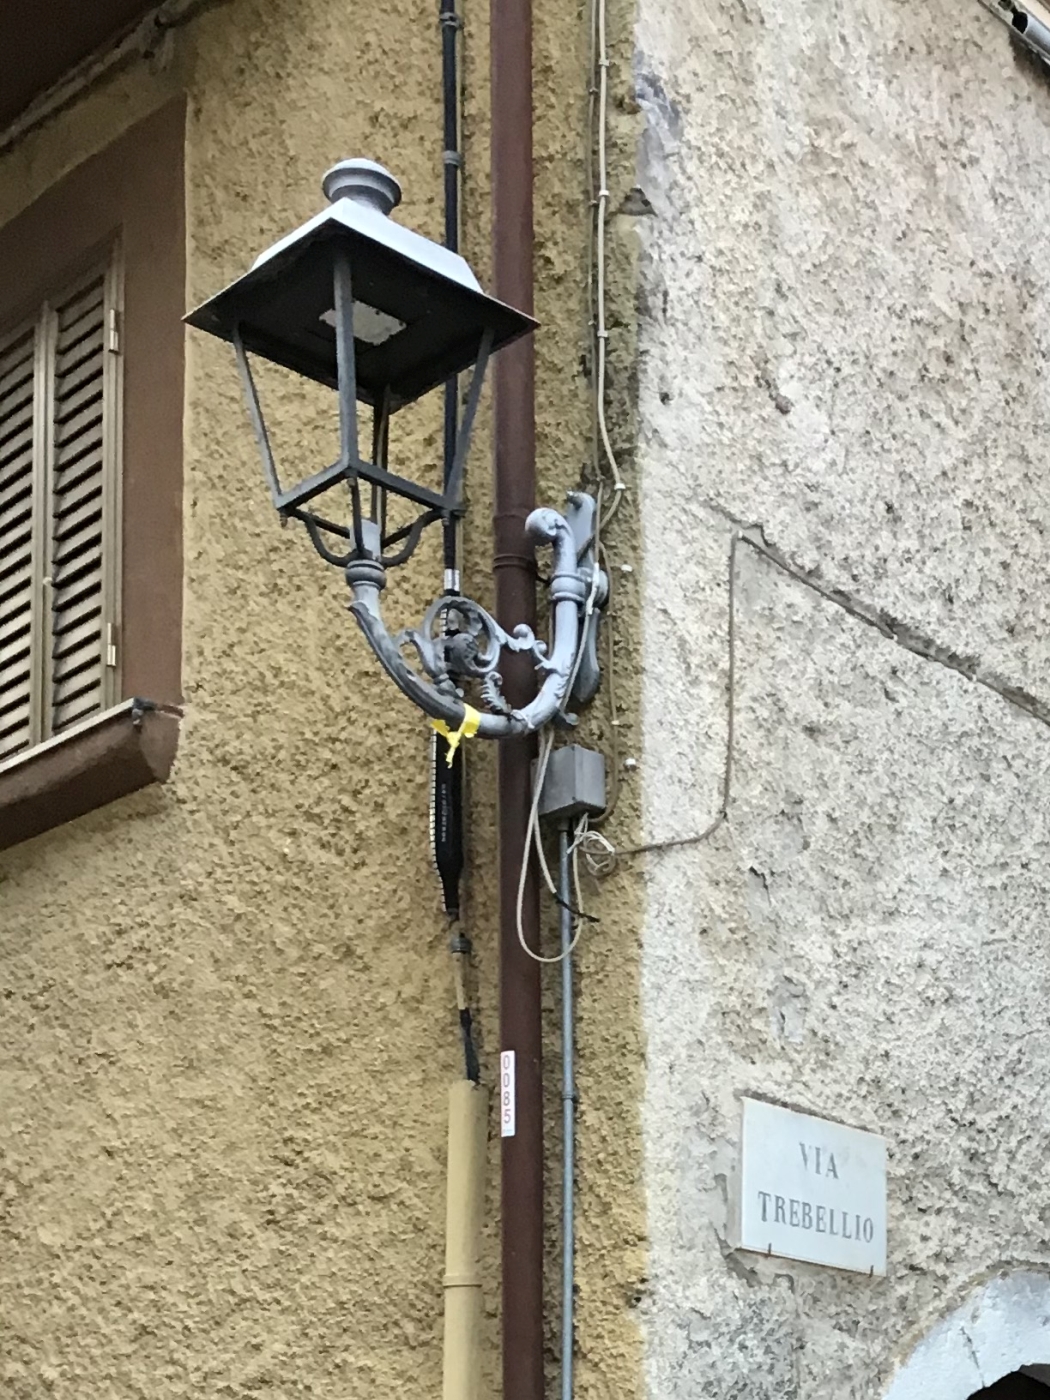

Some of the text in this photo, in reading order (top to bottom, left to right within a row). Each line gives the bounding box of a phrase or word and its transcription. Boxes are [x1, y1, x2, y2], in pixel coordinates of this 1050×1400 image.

[503, 1054, 511, 1124] 0085
[799, 1141, 839, 1180] VIA
[757, 1190, 875, 1244] TREBELLIO
